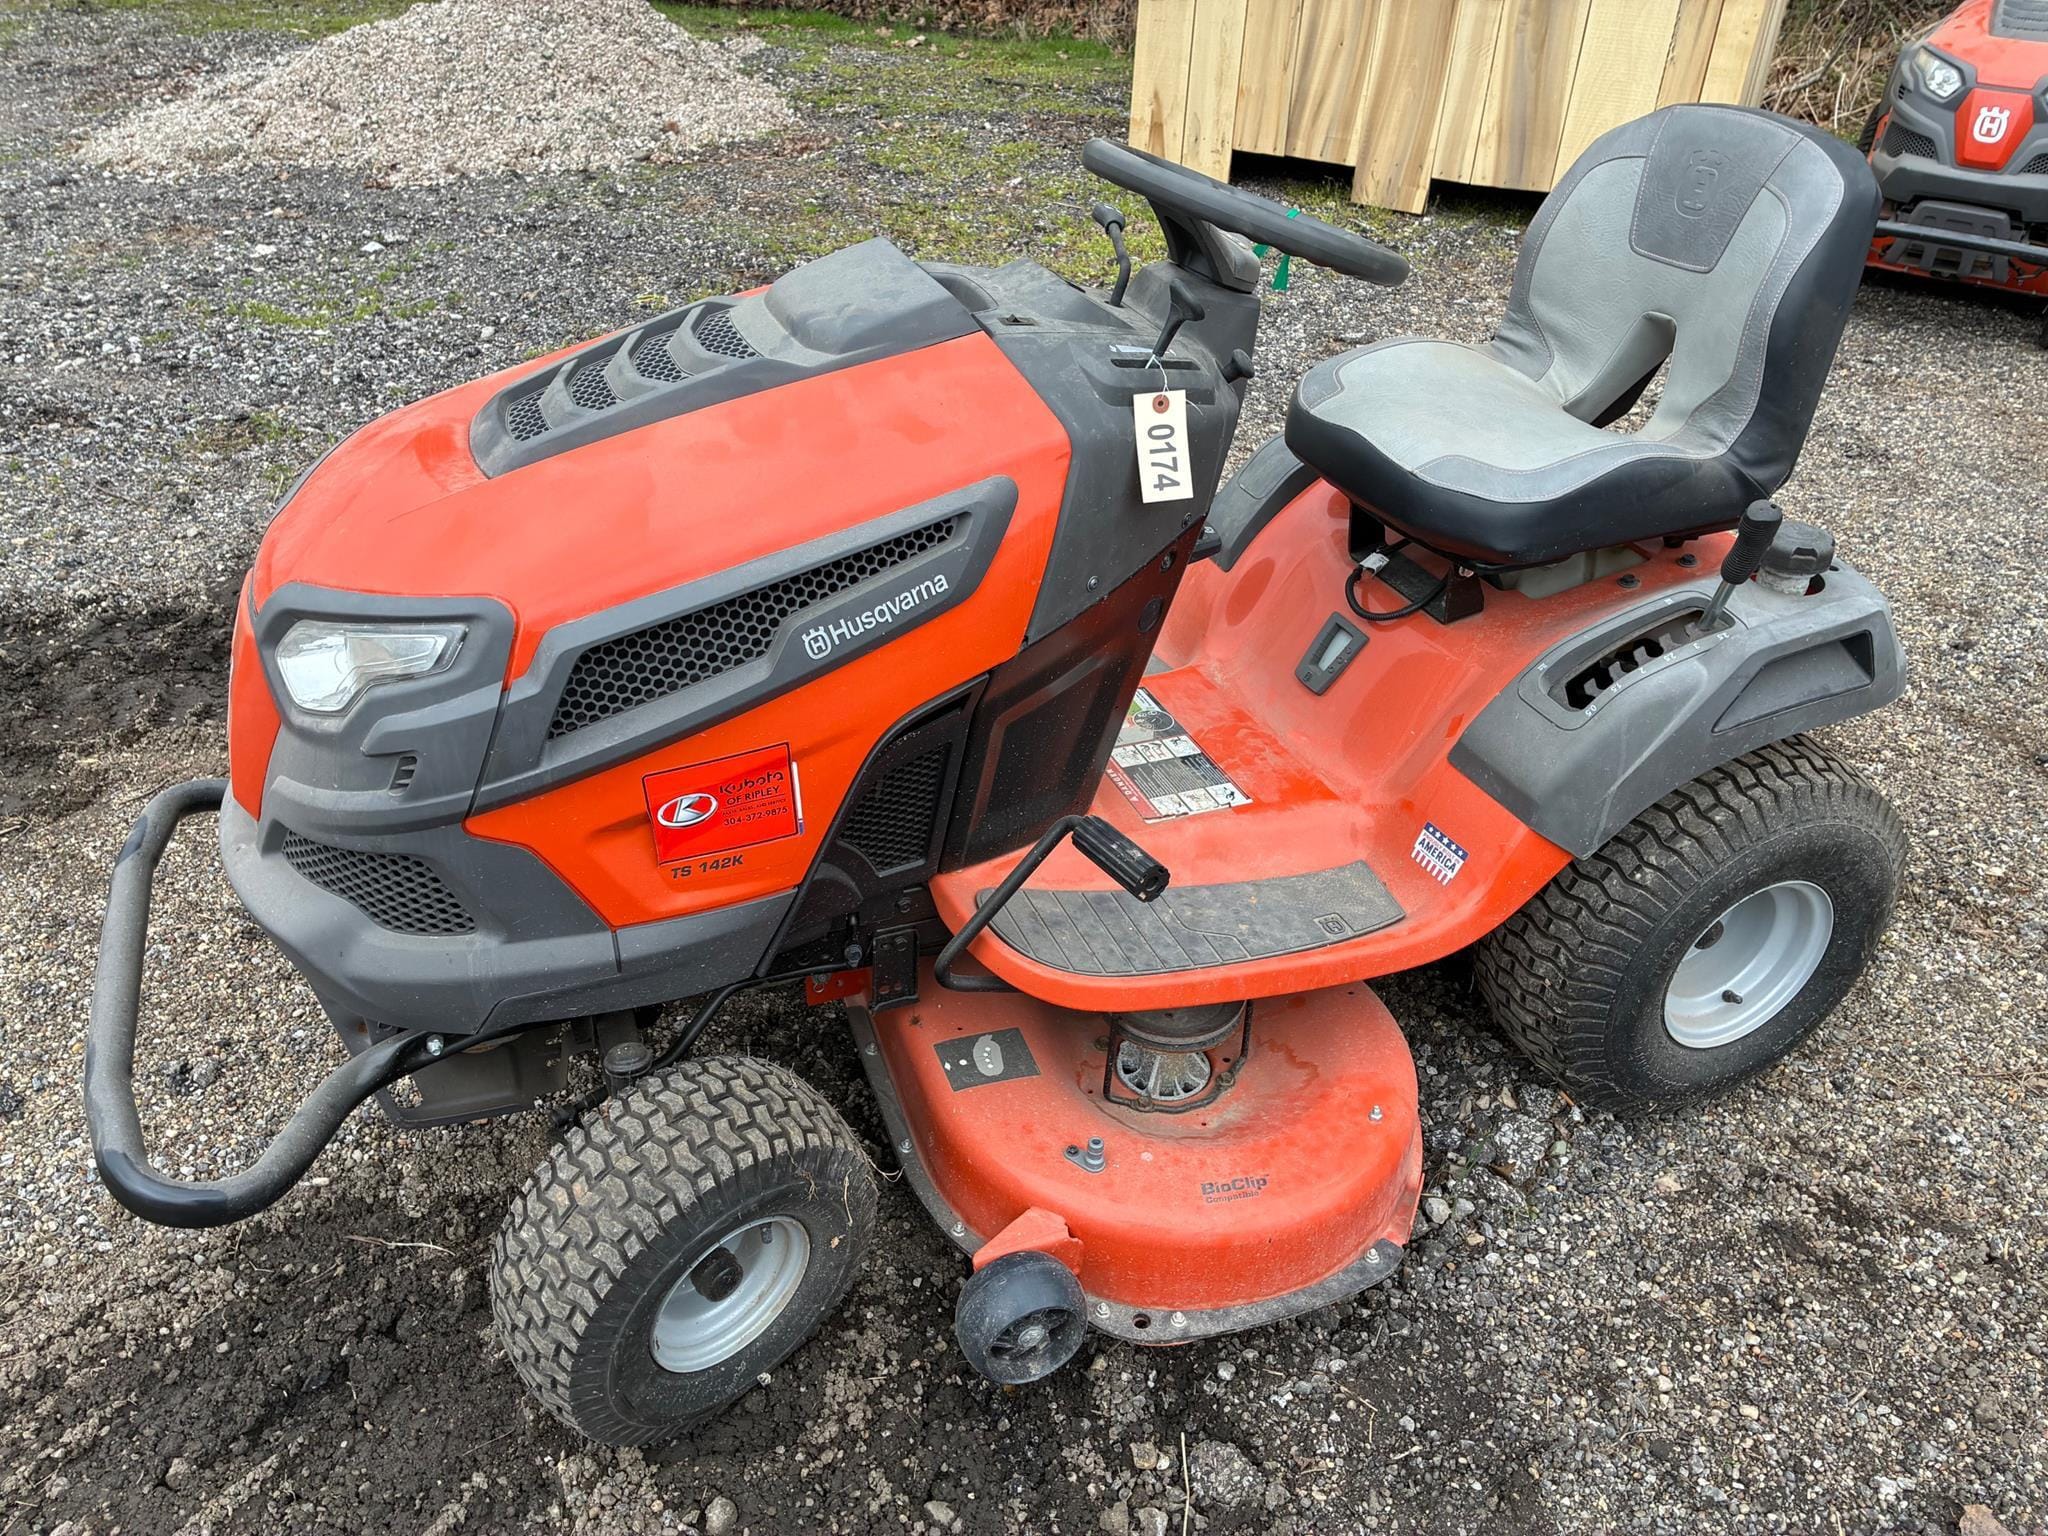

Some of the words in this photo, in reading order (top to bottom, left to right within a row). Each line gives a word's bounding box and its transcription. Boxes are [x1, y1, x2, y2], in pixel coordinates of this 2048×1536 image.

[1147, 424, 1180, 491] 0174
[828, 574, 949, 646] Husqvarna
[719, 770, 784, 794] Kubota
[726, 795, 742, 805] OF
[745, 786, 779, 801] RIPLEY
[724, 806, 788, 825] 304-372-9875
[670, 866, 692, 879] TS
[698, 855, 744, 873] 142K
[1418, 838, 1457, 873] AMERICA
[1201, 1176, 1267, 1196] BioClip
[1206, 1190, 1259, 1203] Compatible
